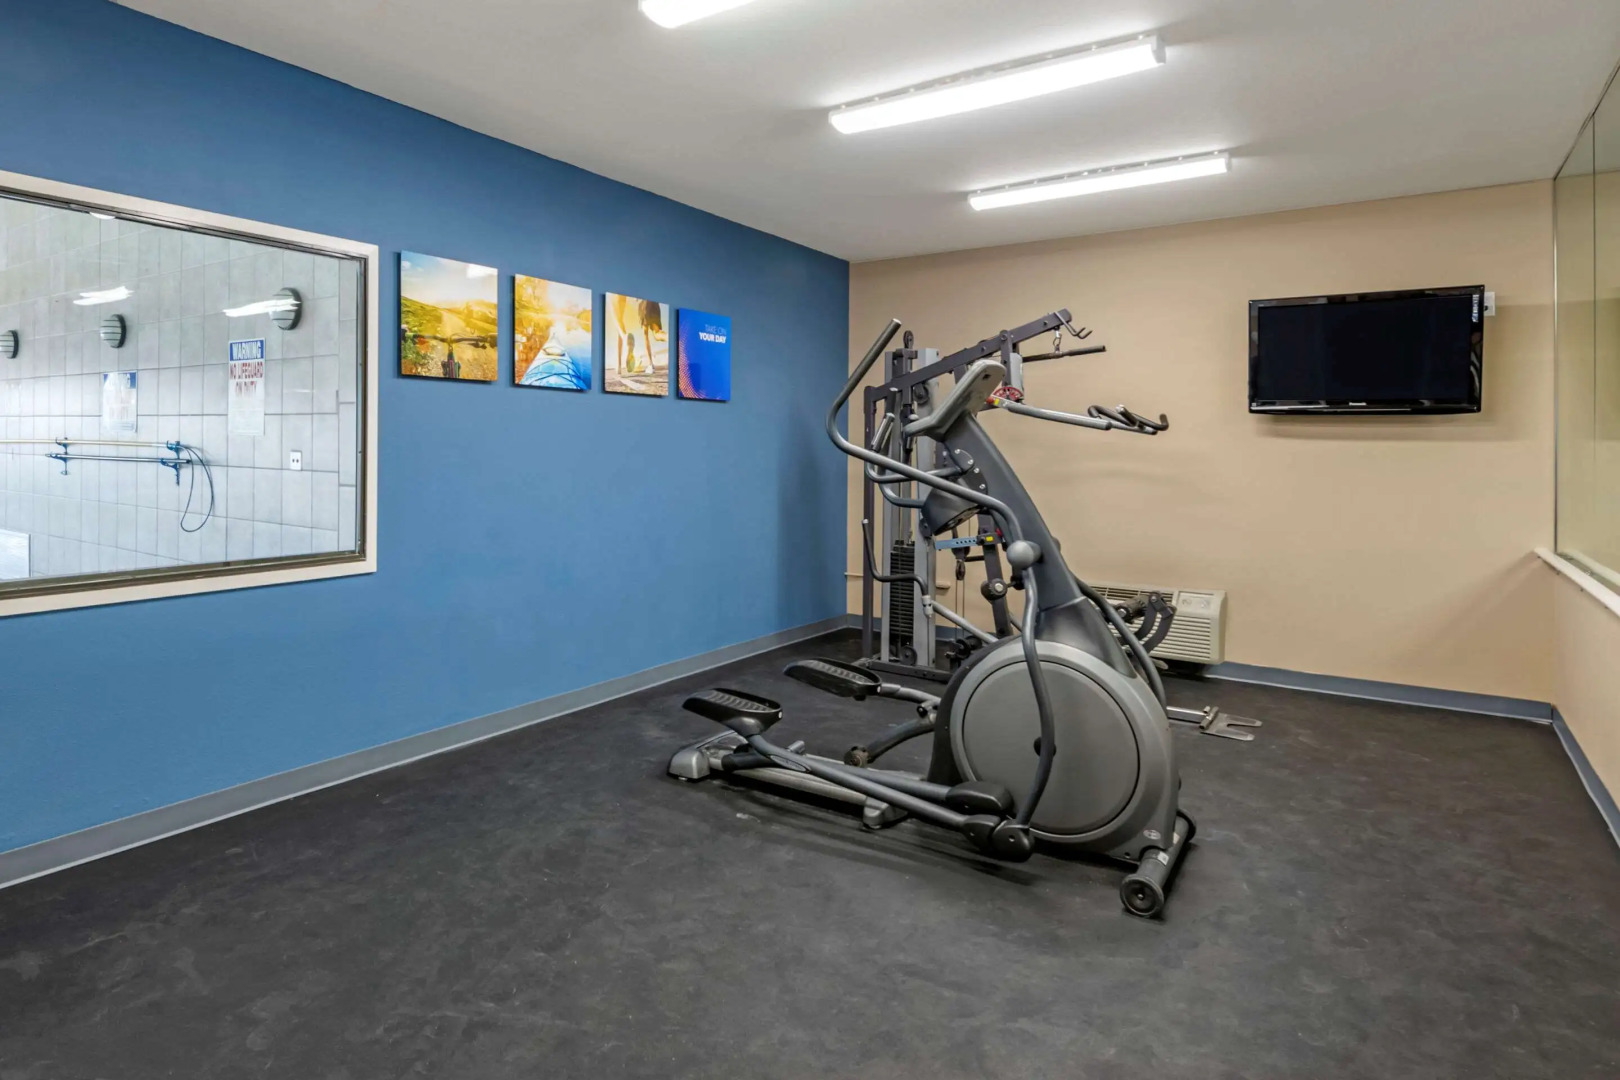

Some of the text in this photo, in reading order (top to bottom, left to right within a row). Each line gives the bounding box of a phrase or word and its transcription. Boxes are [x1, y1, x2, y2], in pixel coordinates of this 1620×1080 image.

[699, 331, 726, 344] YOUR DAY
[232, 341, 261, 360] WARNING
[230, 362, 263, 380] NO LIFEGUARD
